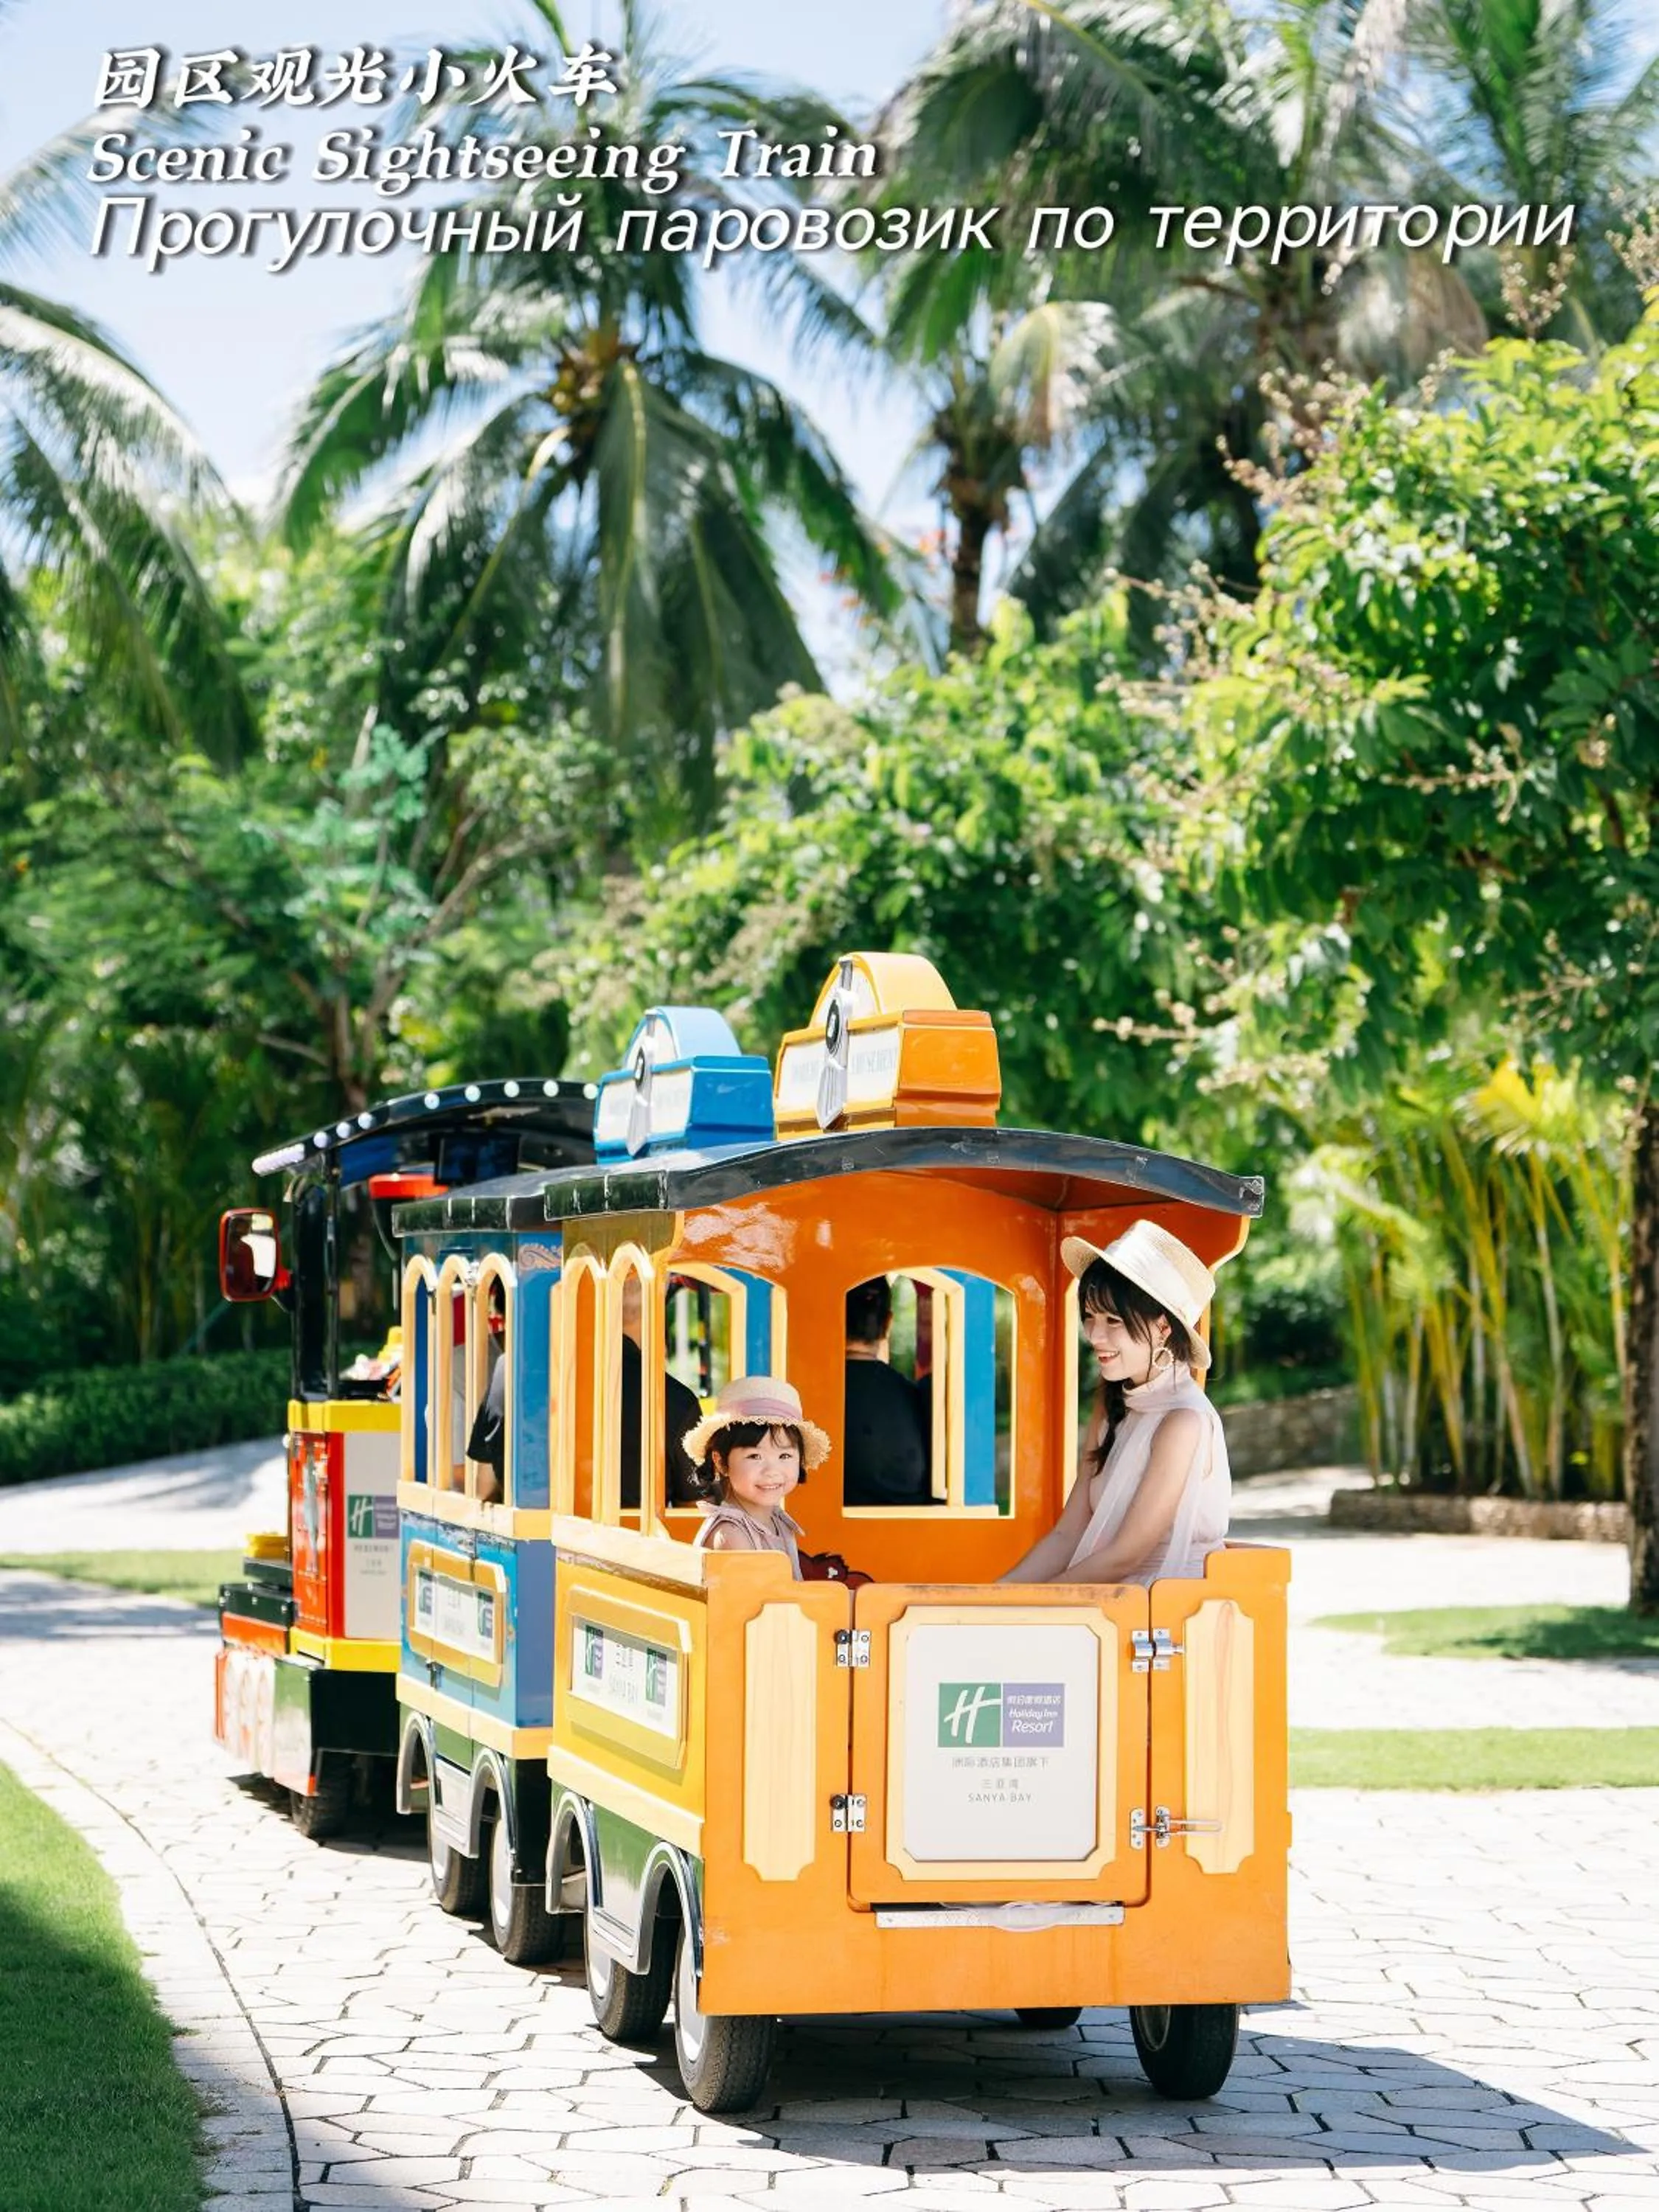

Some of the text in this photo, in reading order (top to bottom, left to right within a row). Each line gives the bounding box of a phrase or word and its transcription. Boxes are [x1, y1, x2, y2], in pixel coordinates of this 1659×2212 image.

[1009, 1708, 1043, 1720] Holiday
[1012, 1719, 1054, 1733] Resort
[967, 1792, 1032, 1803] SANYA BAY
